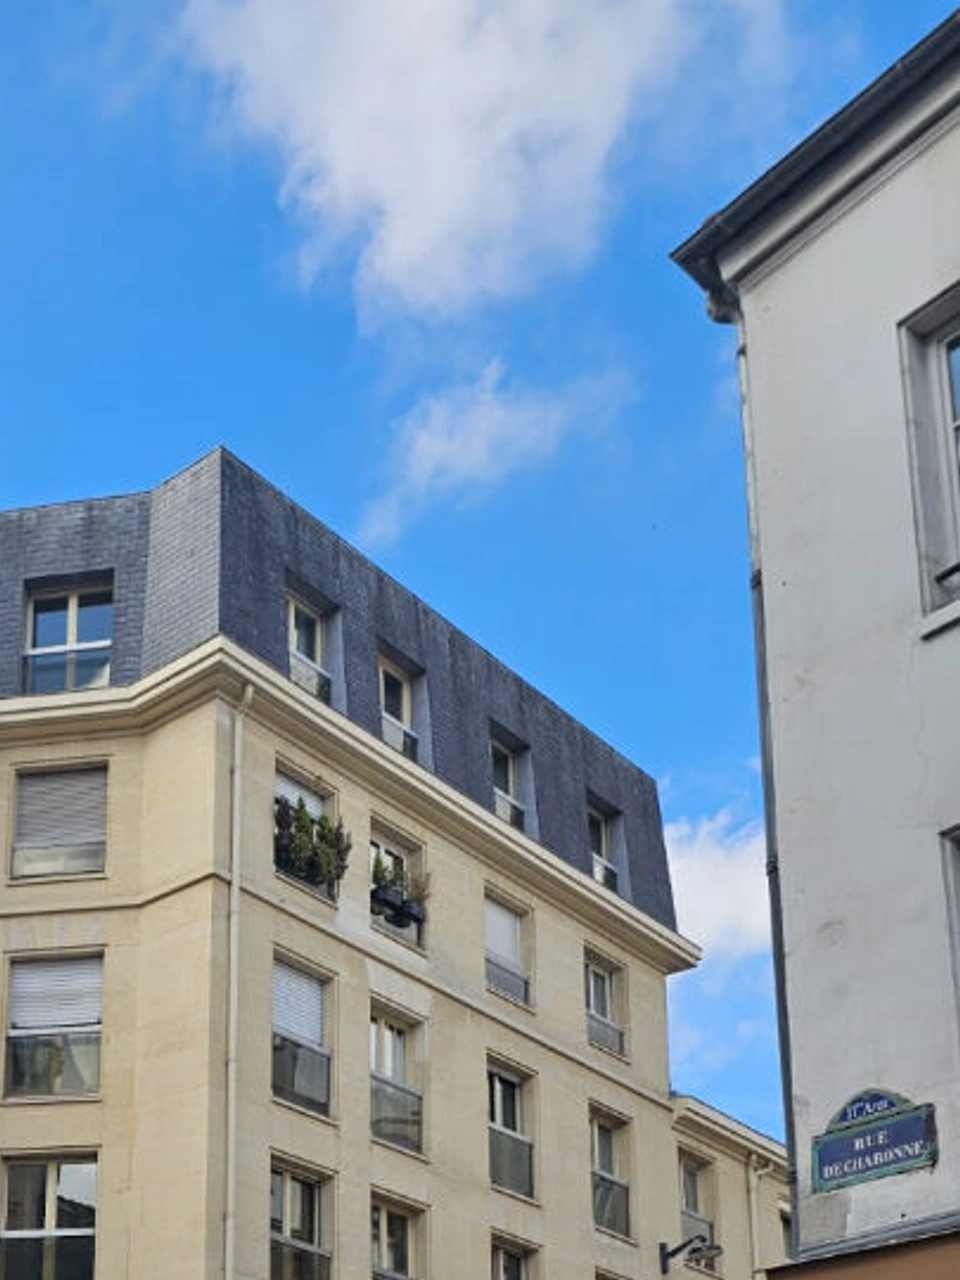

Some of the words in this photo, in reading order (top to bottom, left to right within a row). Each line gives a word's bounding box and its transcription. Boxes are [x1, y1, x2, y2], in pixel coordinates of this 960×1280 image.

[854, 1130, 889, 1151] RUE
[823, 1162, 842, 1179] DE
[843, 1140, 924, 1173] CHARONNE
